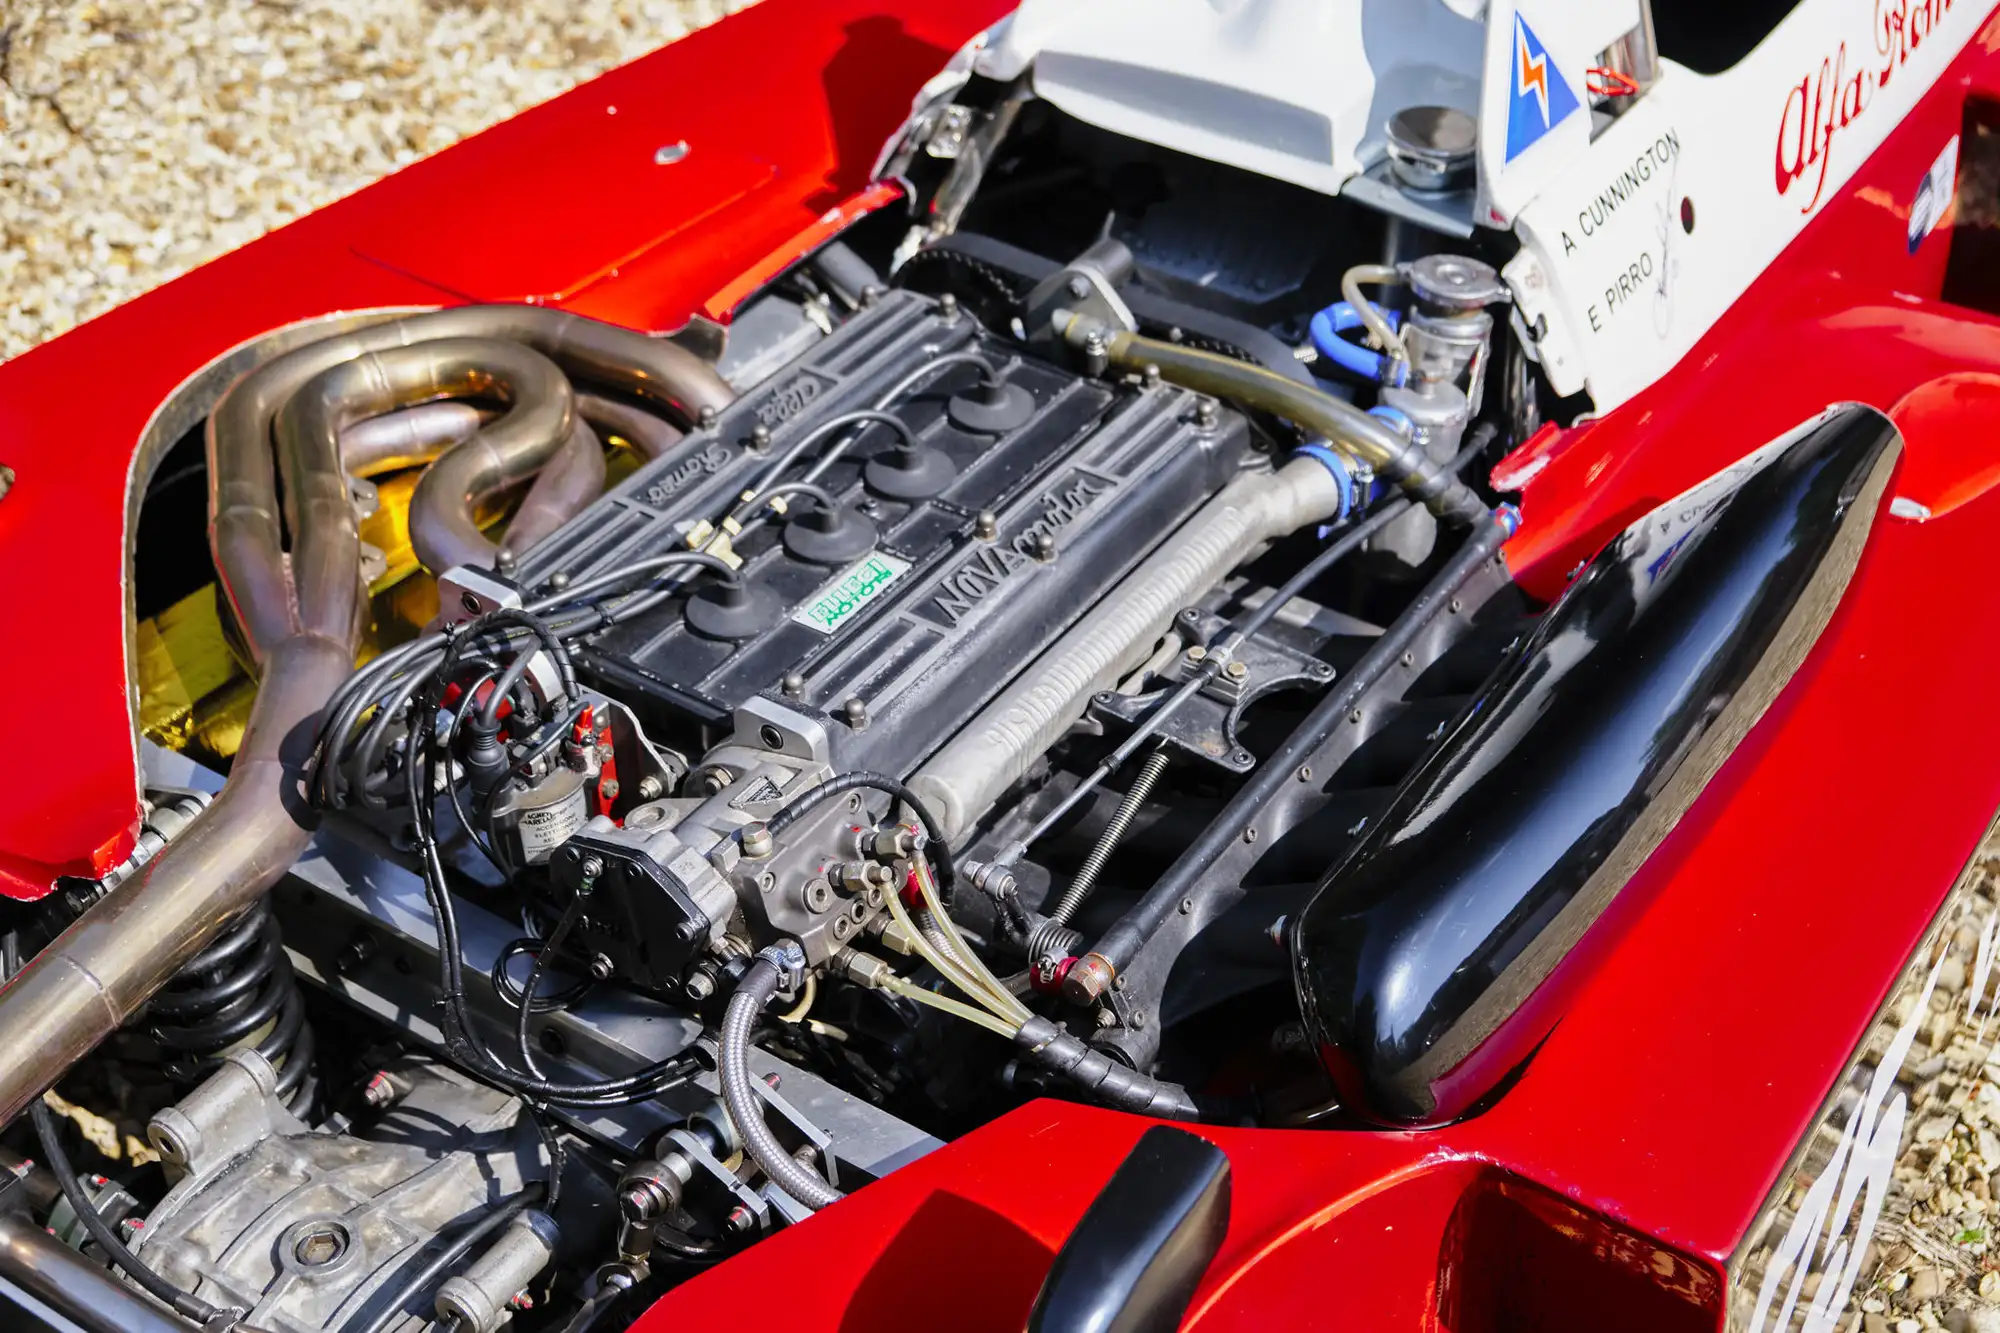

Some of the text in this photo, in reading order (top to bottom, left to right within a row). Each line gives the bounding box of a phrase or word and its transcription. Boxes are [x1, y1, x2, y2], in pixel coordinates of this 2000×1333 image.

[1775, 39, 1873, 214] Alfa
[1560, 230, 1577, 258] A
[1578, 128, 1681, 236] CUNNINGTON
[1587, 252, 1654, 333] E PIRRO
